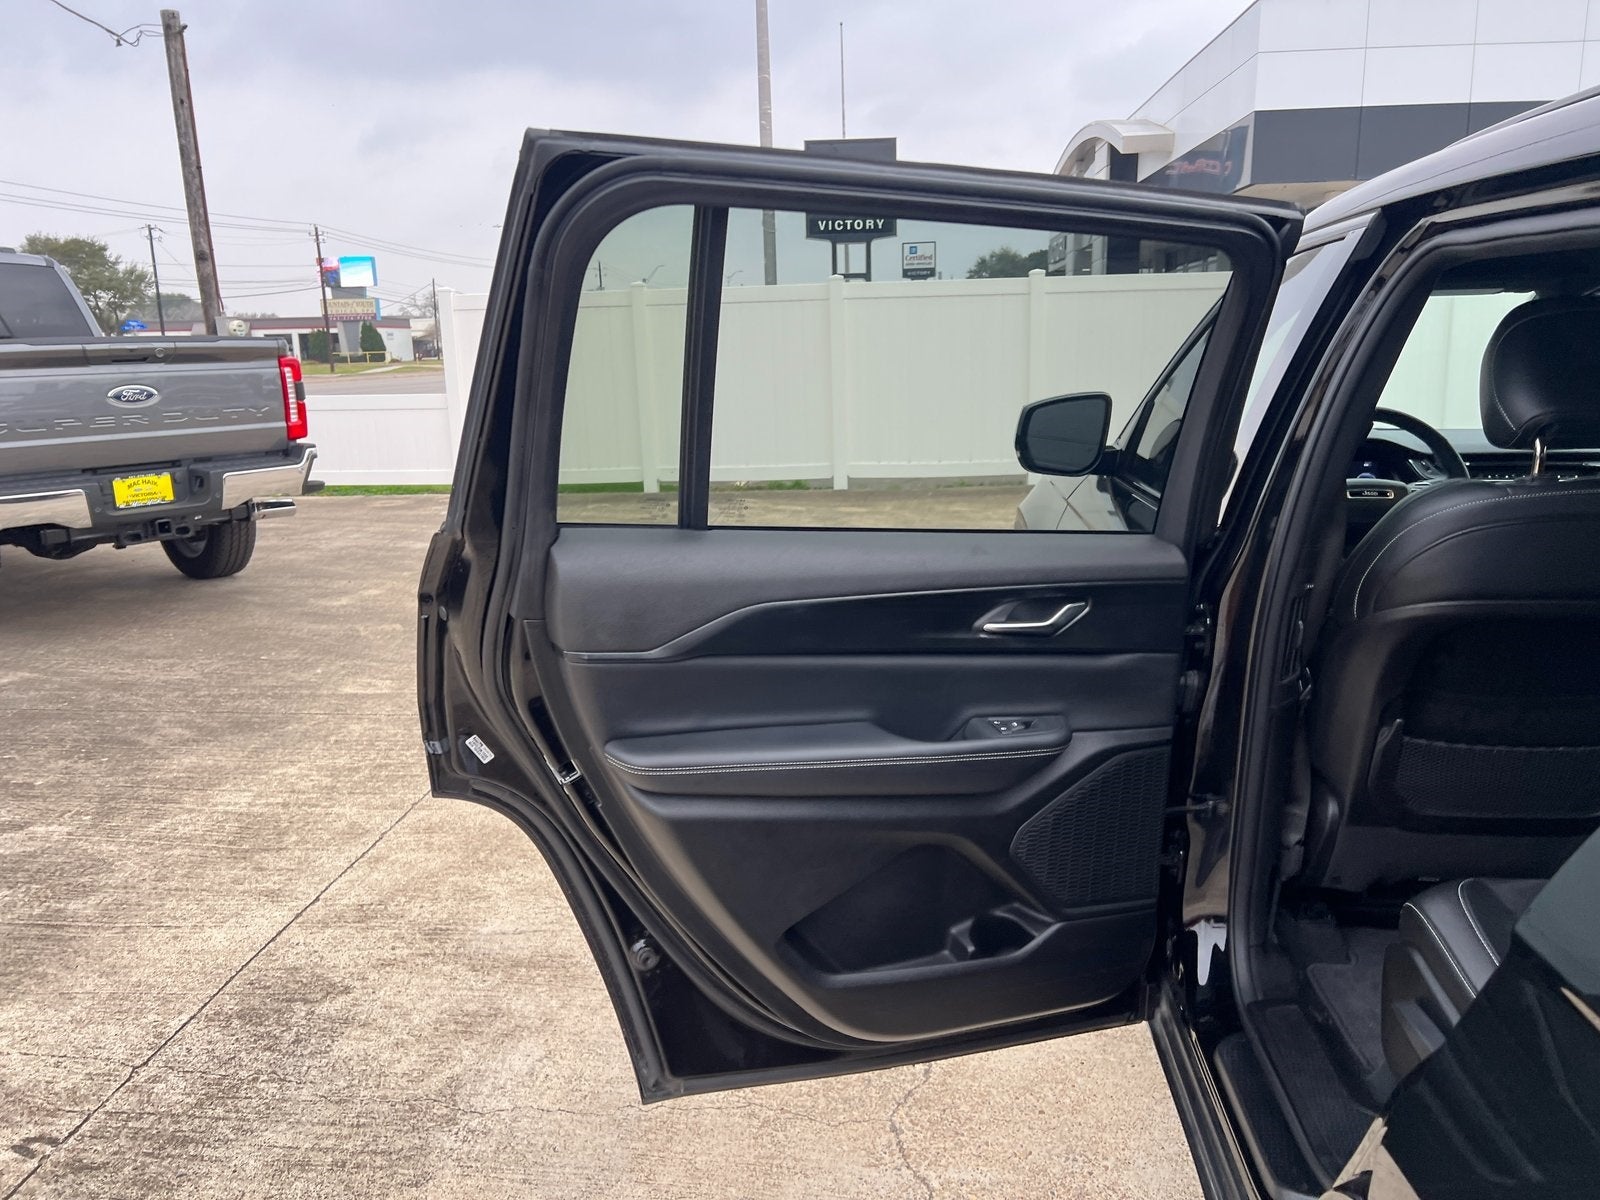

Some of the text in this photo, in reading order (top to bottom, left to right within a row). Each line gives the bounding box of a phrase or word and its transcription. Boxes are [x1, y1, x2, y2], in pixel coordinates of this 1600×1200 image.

[818, 218, 884, 231] VICTORY
[121, 389, 147, 401] Ford
[0, 406, 270, 434] UPER DUTY
[127, 480, 141, 489] MAC
